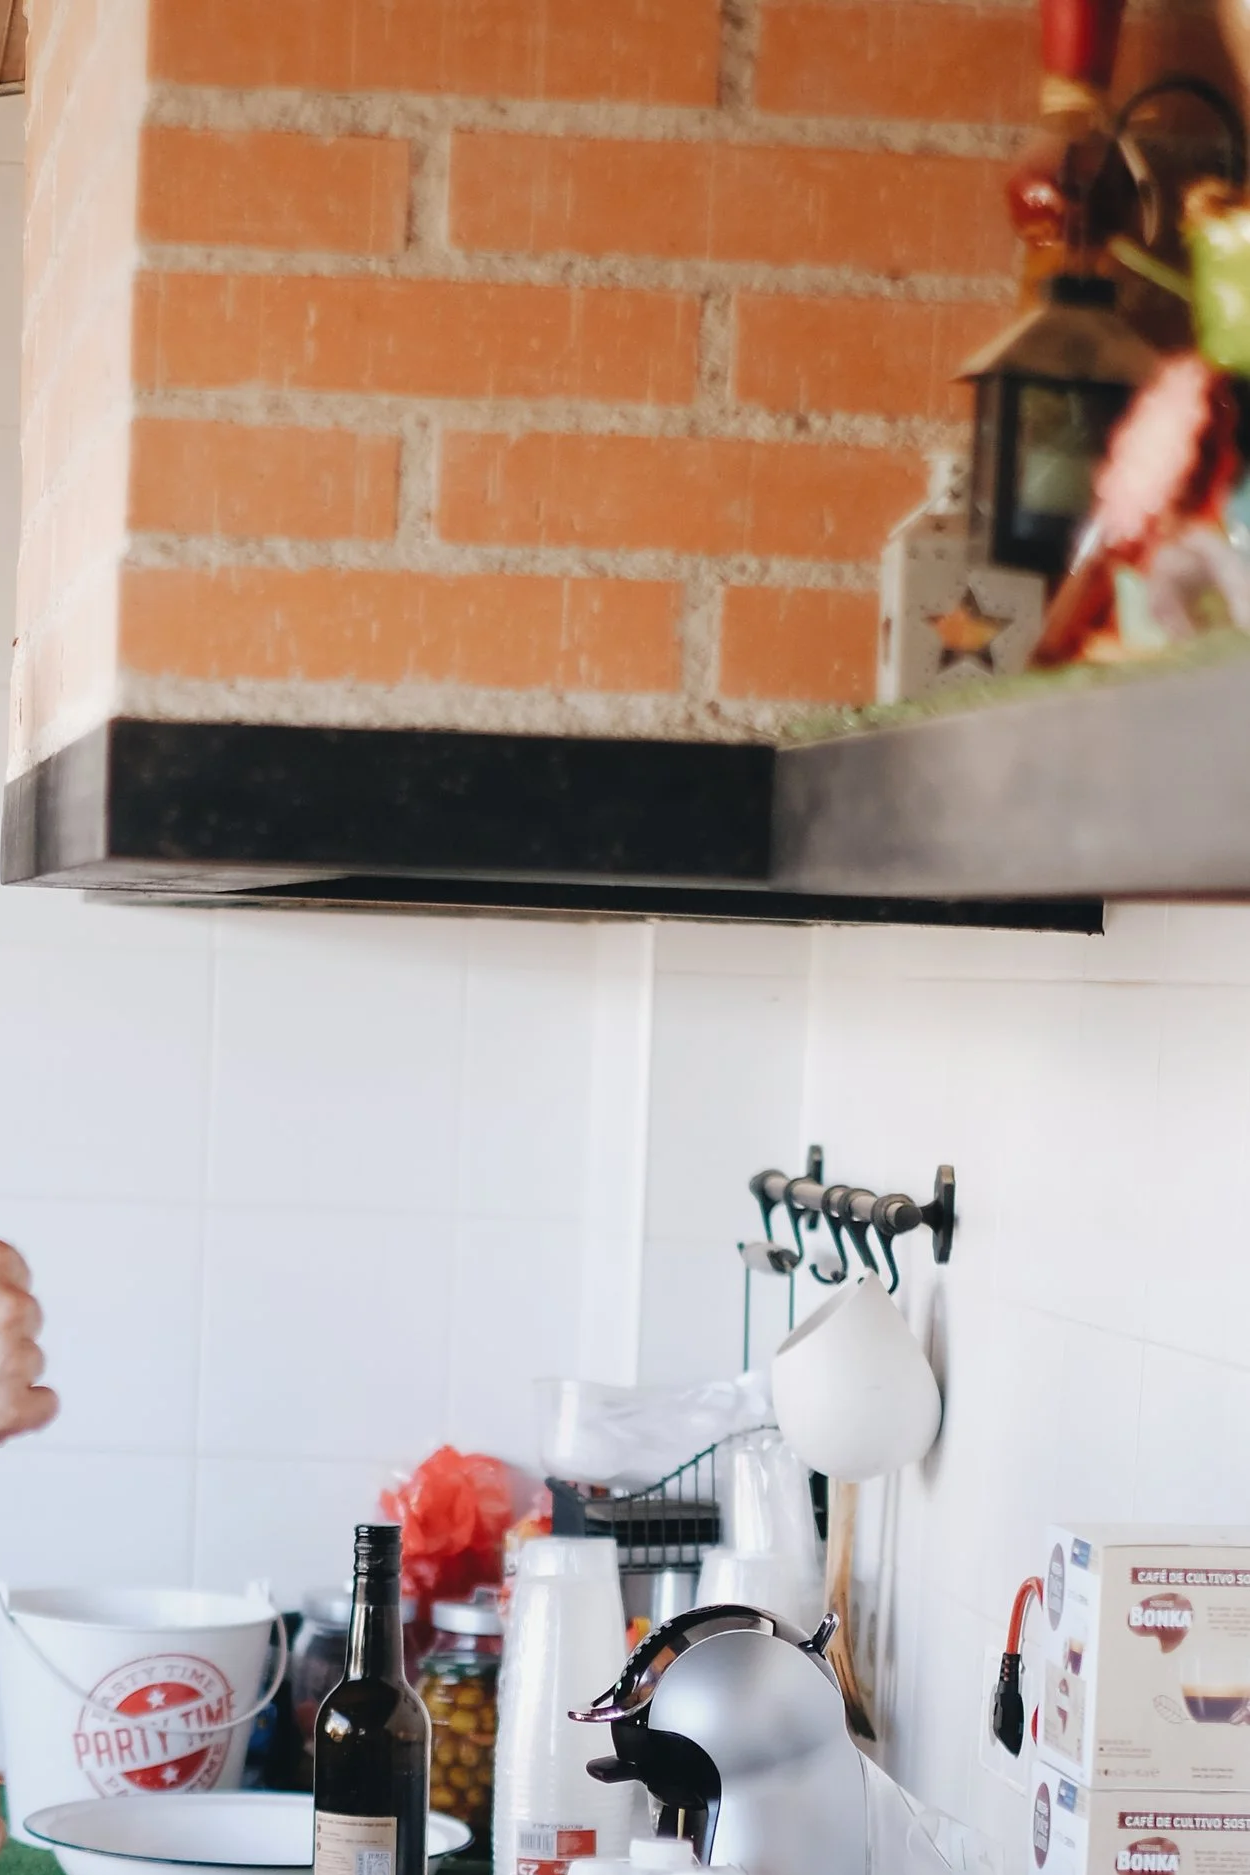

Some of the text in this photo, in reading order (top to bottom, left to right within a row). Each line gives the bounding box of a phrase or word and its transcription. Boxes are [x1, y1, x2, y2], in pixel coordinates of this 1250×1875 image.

[1138, 1569, 1167, 1583] CAFÉ
[1169, 1573, 1185, 1583] DE
[1186, 1573, 1235, 1585] CULTIVO
[73, 1718, 170, 1770] PARTY
[1125, 1814, 1154, 1828] CAFÉ
[1156, 1817, 1172, 1828] DE
[1173, 1817, 1222, 1829] CULTIVO
